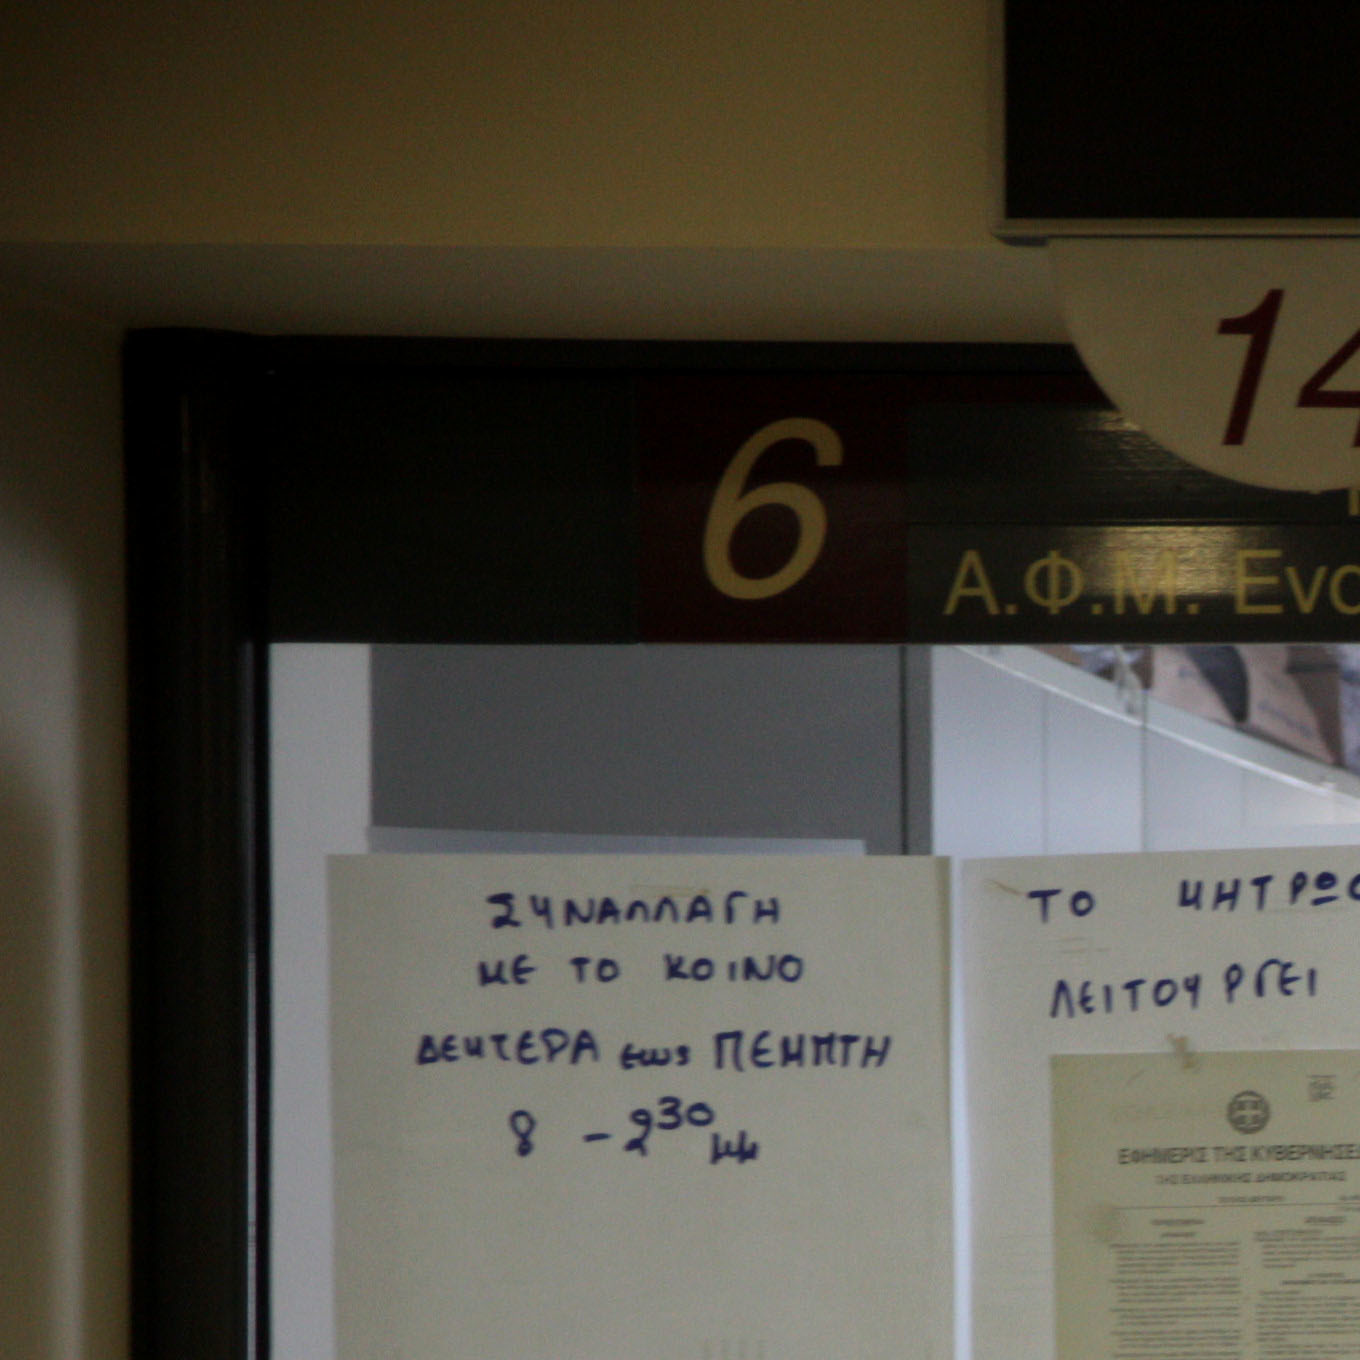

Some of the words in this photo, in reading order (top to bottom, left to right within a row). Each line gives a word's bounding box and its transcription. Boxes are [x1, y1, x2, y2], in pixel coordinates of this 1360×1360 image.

[700, 415, 846, 601] 6
[944, 547, 1200, 616] Α.Φ.Μ.
[1027, 889, 1095, 922] ΤΟ
[478, 954, 535, 986] ΜΕ
[570, 957, 620, 982] ΤΟ
[664, 954, 802, 982] ΚΟΙΝΟ
[1050, 961, 1320, 1018] ΛΕΙΤΟΥΡΓΕΙ
[416, 1028, 598, 1065] ΔΕΥΤΕΡΑ
[714, 1030, 891, 1072] ΠΕΜΠΤΗ
[1213, 1145, 1247, 1163] ΤΗΣ
